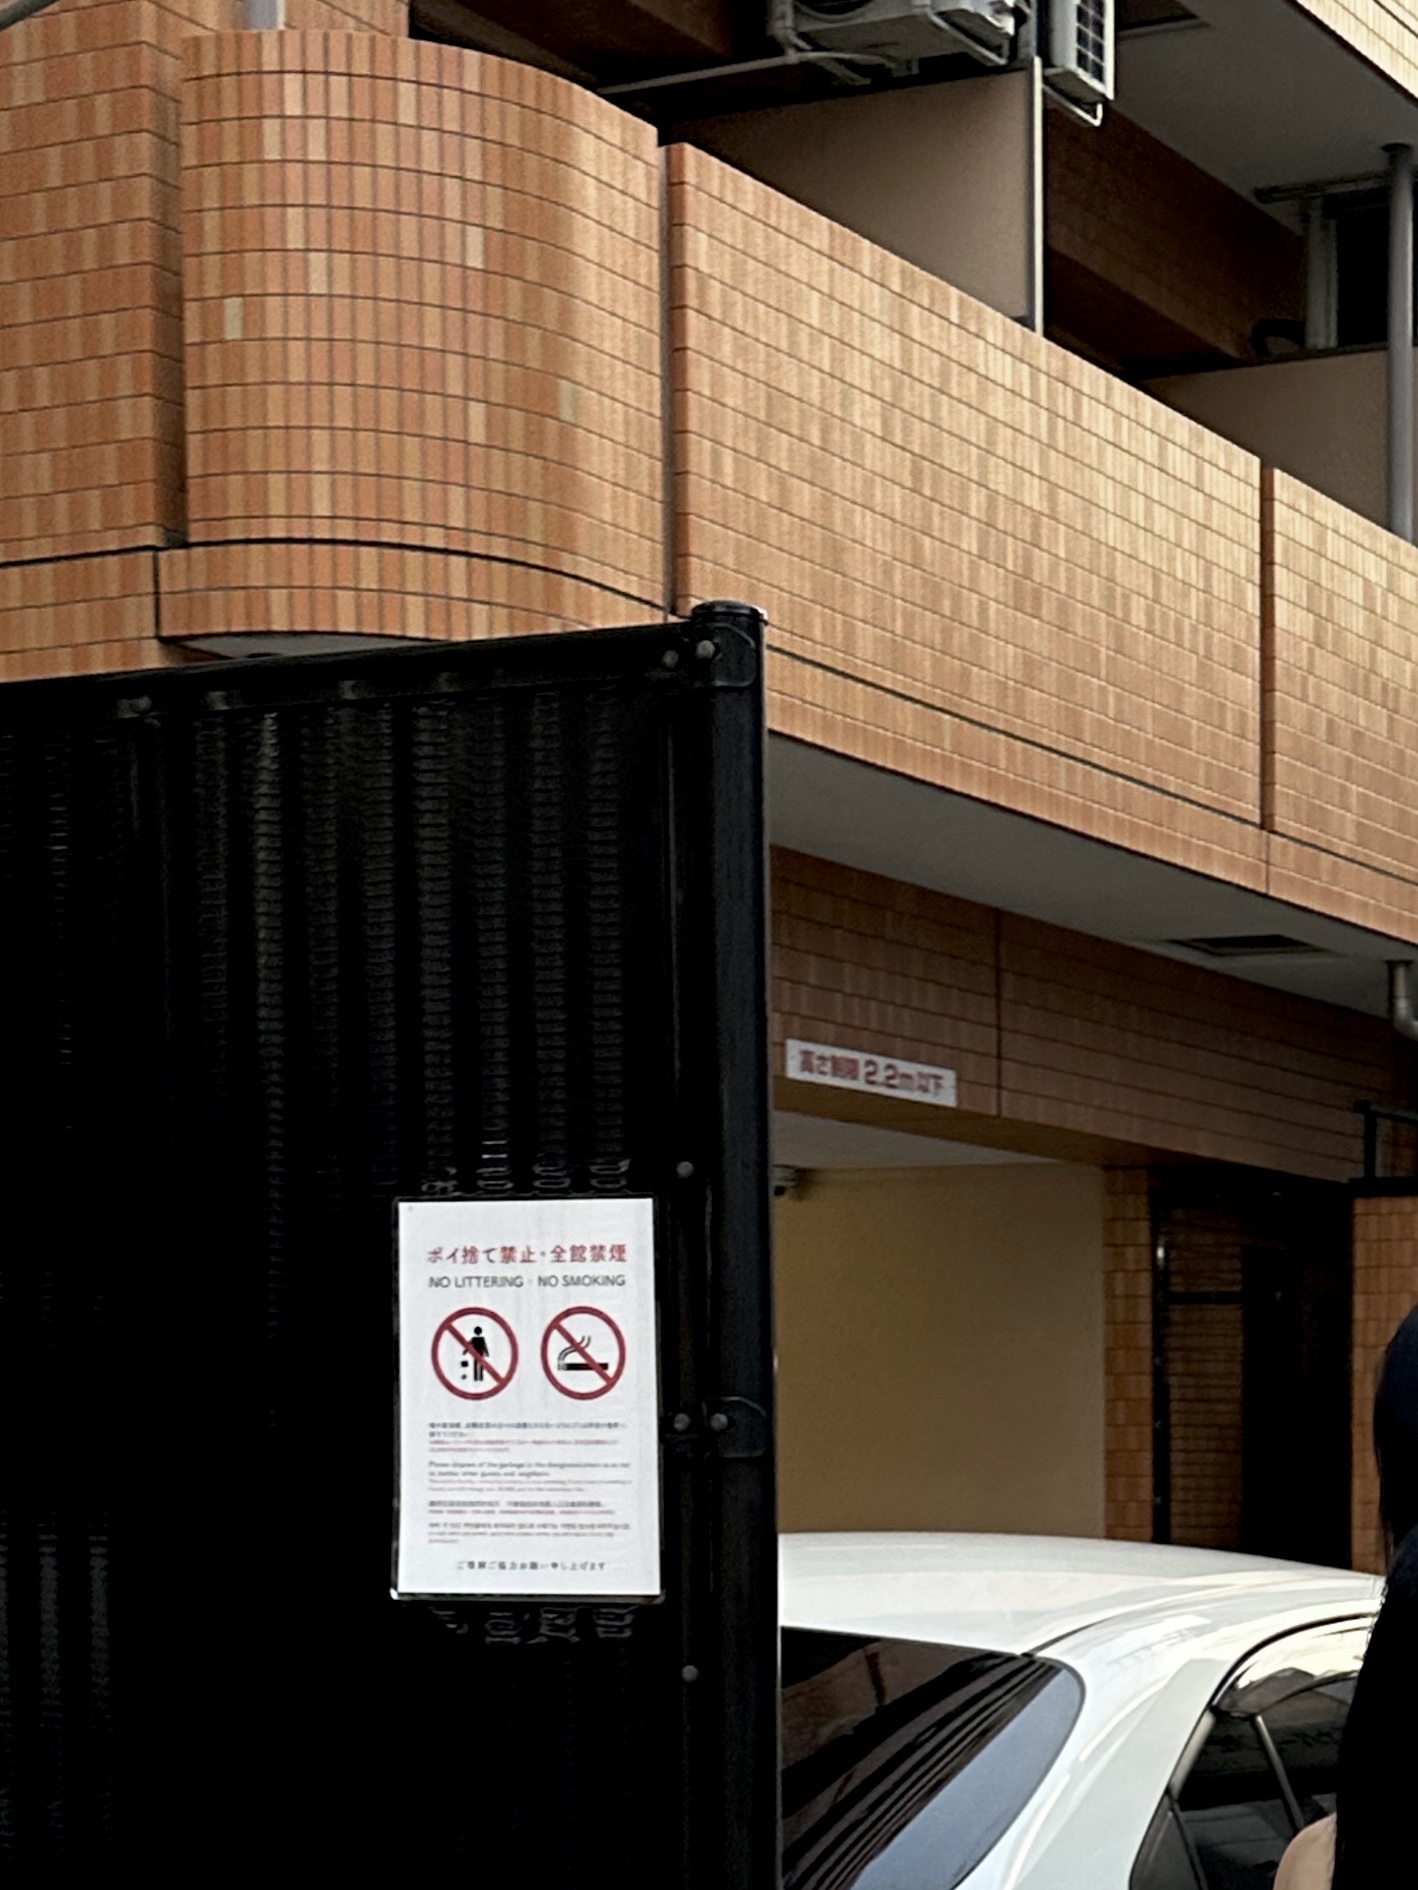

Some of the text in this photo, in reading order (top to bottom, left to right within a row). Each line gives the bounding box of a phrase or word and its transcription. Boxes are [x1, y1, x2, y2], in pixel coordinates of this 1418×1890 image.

[427, 1244, 627, 1265] ポイ捨て禁止・全館禁煙
[428, 1274, 626, 1288] NO LITTERING NO SMOKING
